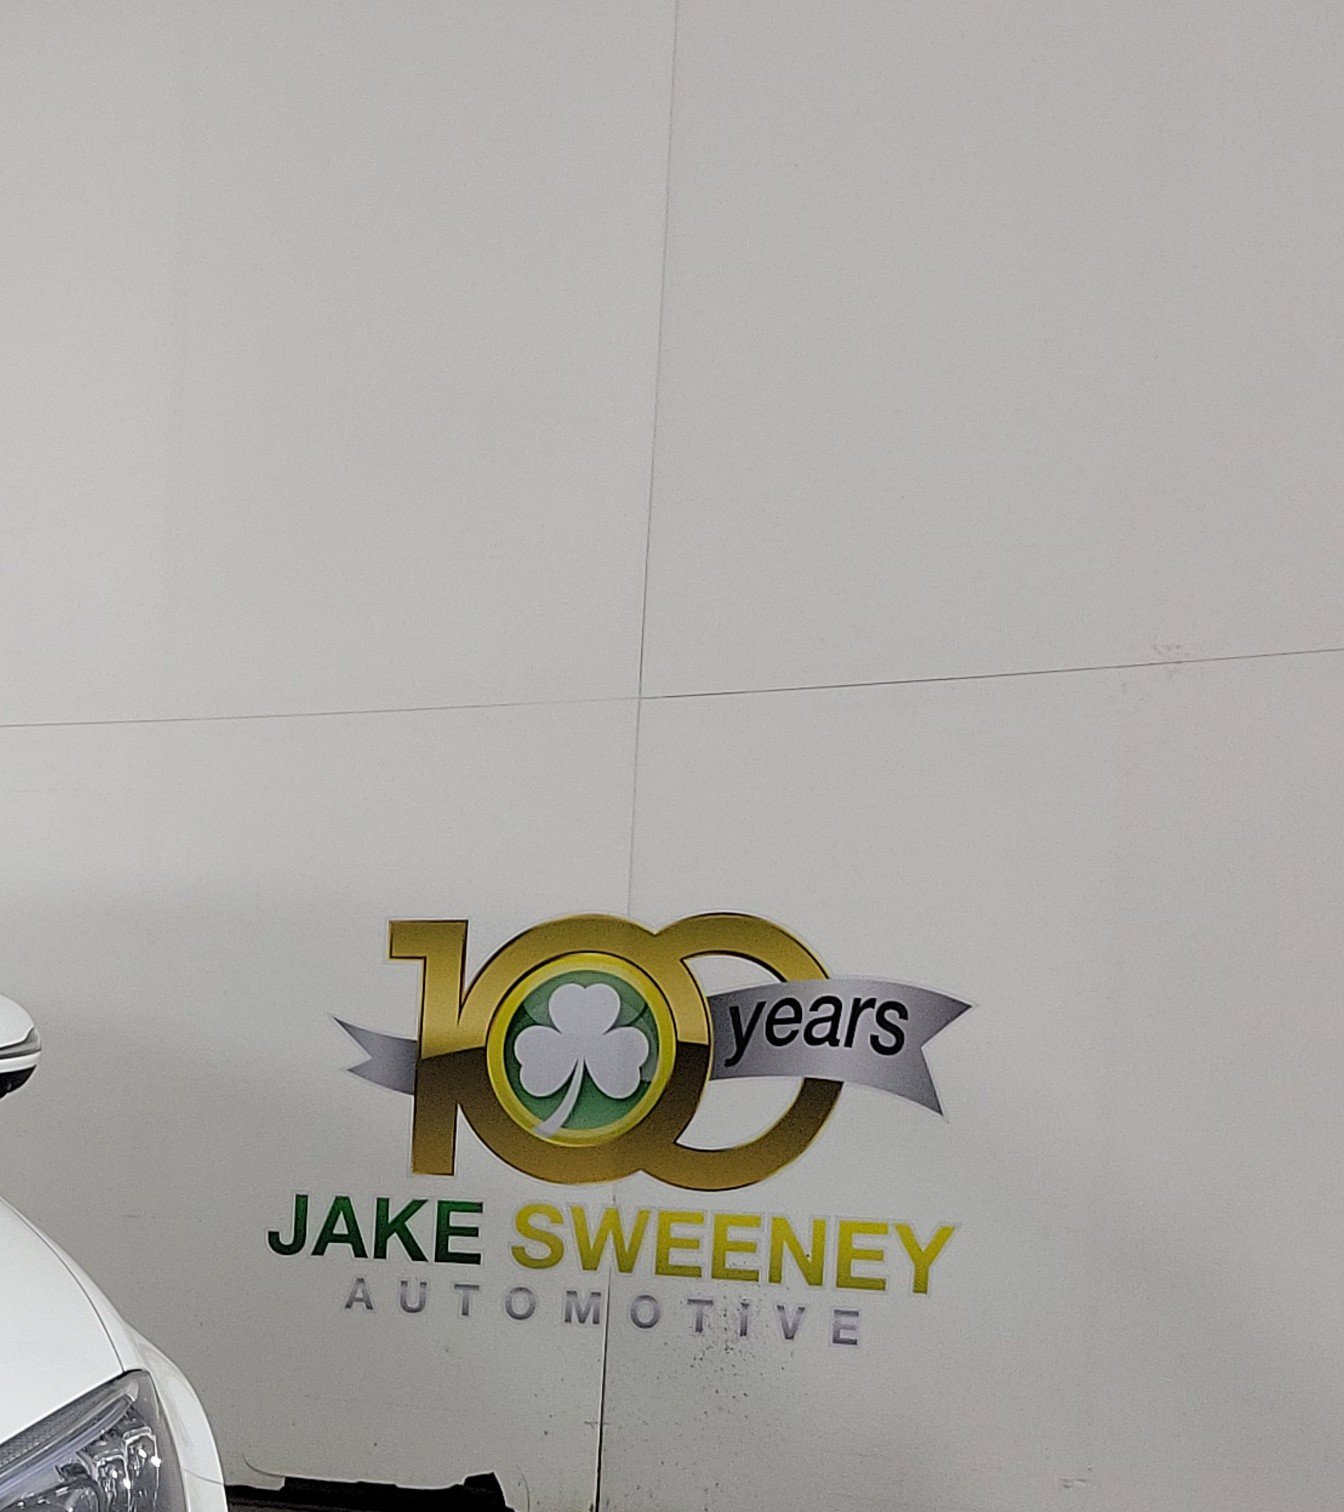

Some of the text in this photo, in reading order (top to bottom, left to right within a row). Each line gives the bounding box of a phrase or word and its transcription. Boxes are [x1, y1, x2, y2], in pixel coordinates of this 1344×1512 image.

[388, 912, 910, 1192] 100 years
[267, 1193, 956, 1296] JAKE SWEENEY
[344, 1276, 862, 1347] AUTOMOTIVE
